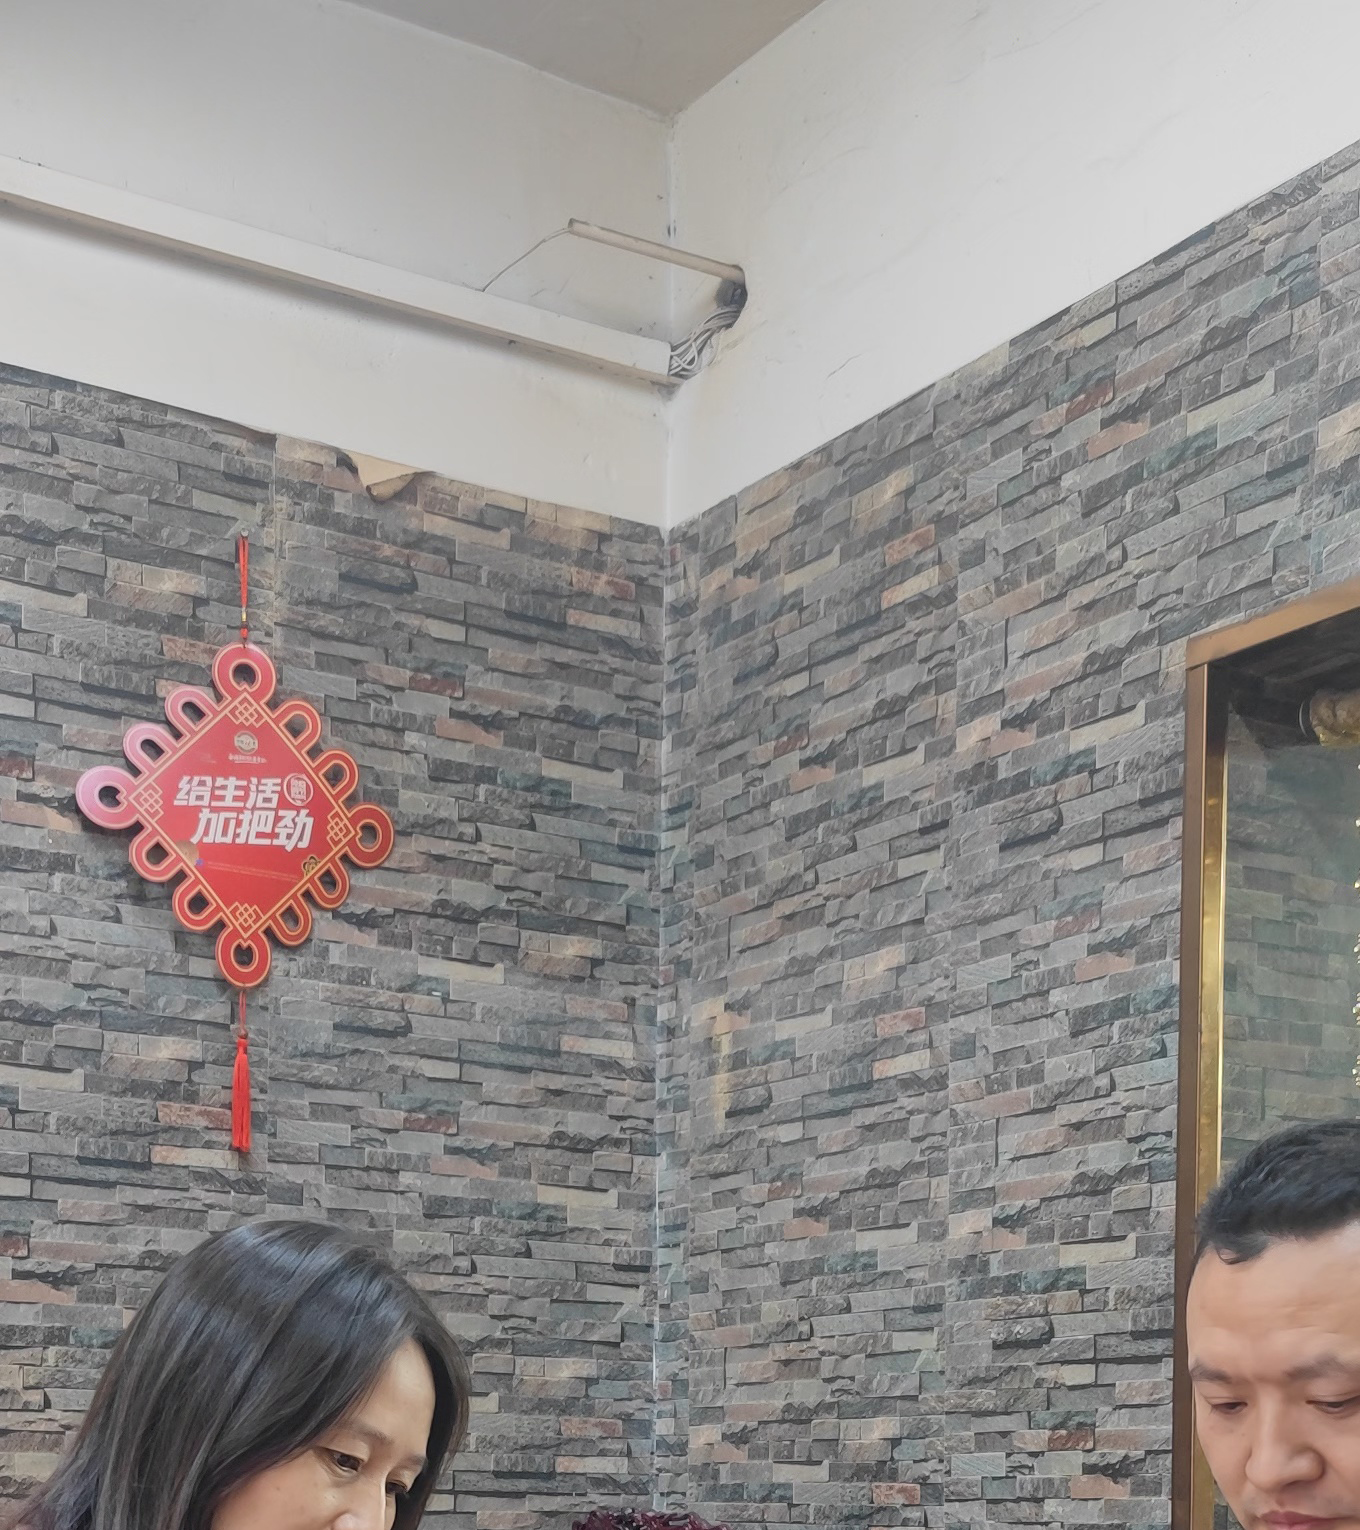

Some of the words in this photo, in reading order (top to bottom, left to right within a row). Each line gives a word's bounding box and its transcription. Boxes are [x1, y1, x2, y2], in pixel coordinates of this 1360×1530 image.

[173, 775, 281, 809] 给生活
[190, 808, 314, 851] 加把劲
